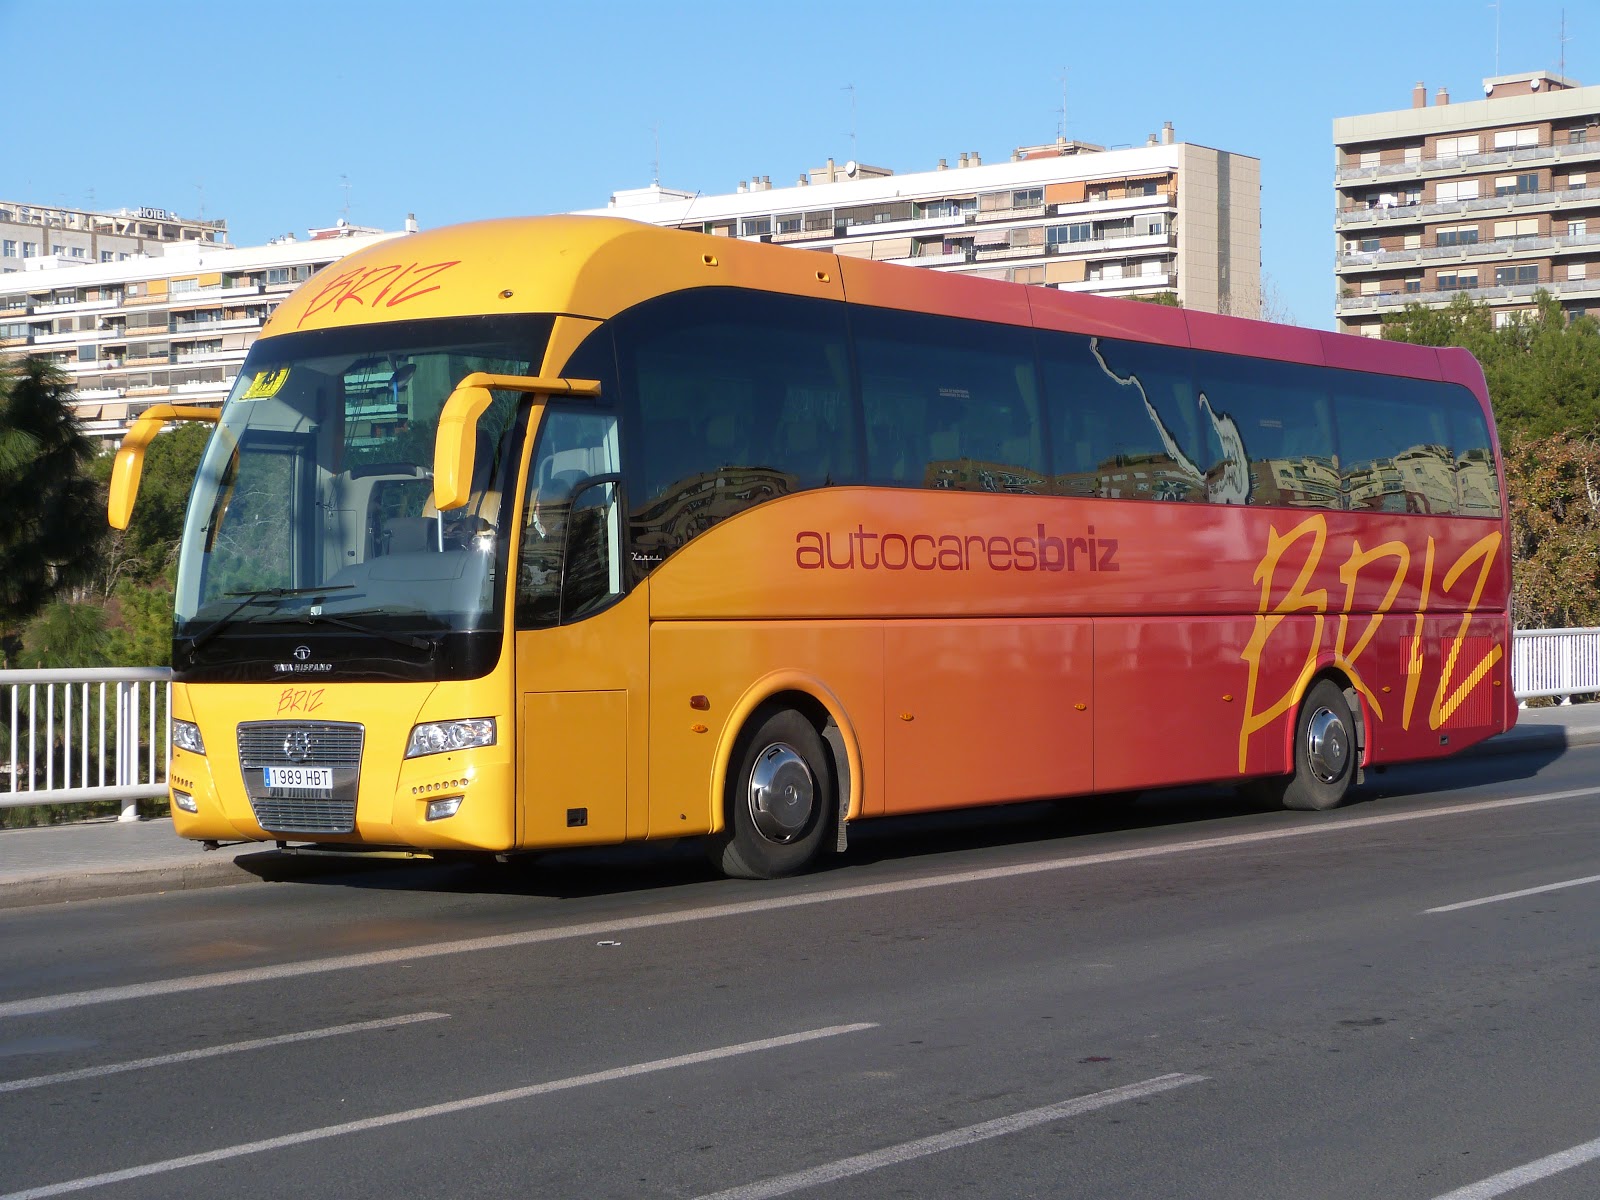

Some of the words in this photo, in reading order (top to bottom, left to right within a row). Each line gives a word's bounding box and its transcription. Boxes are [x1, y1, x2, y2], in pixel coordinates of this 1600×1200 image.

[139, 206, 166, 220] HOTEL
[297, 260, 462, 329] BRIZ
[796, 523, 1120, 571] autocaresbriz
[1239, 513, 1502, 773] BRIZ
[274, 663, 293, 672] TATA
[294, 663, 332, 672] HISPANO
[276, 687, 325, 715] BRIZ
[272, 769, 302, 785] 1989
[305, 770, 328, 785] HBT
